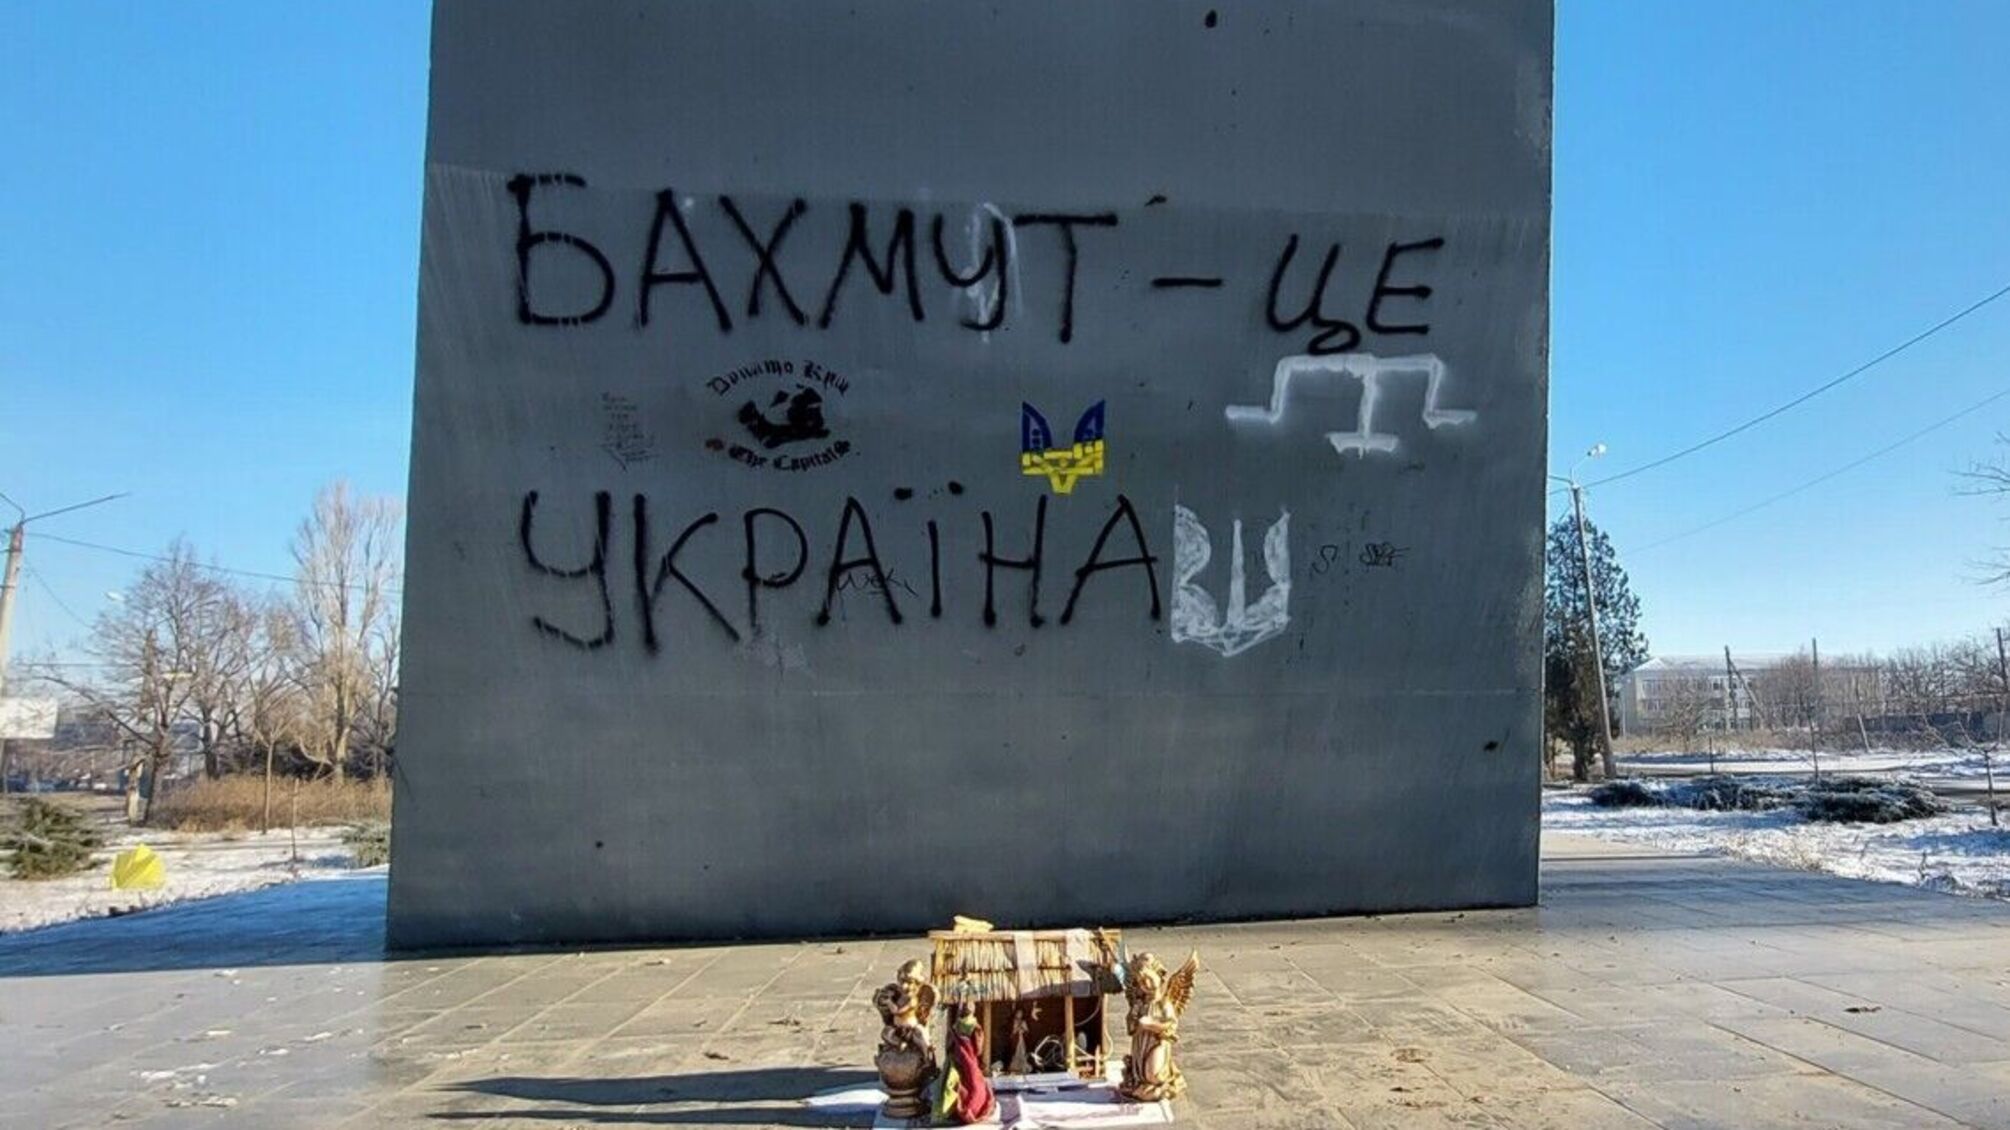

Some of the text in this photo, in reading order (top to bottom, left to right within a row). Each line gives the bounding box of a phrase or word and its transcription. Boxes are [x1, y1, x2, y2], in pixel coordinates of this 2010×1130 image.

[508, 173, 1117, 342] БАХМУТ
[1267, 234, 1445, 355] ЦЕ
[520, 480, 1161, 654] УКРАЇНА
